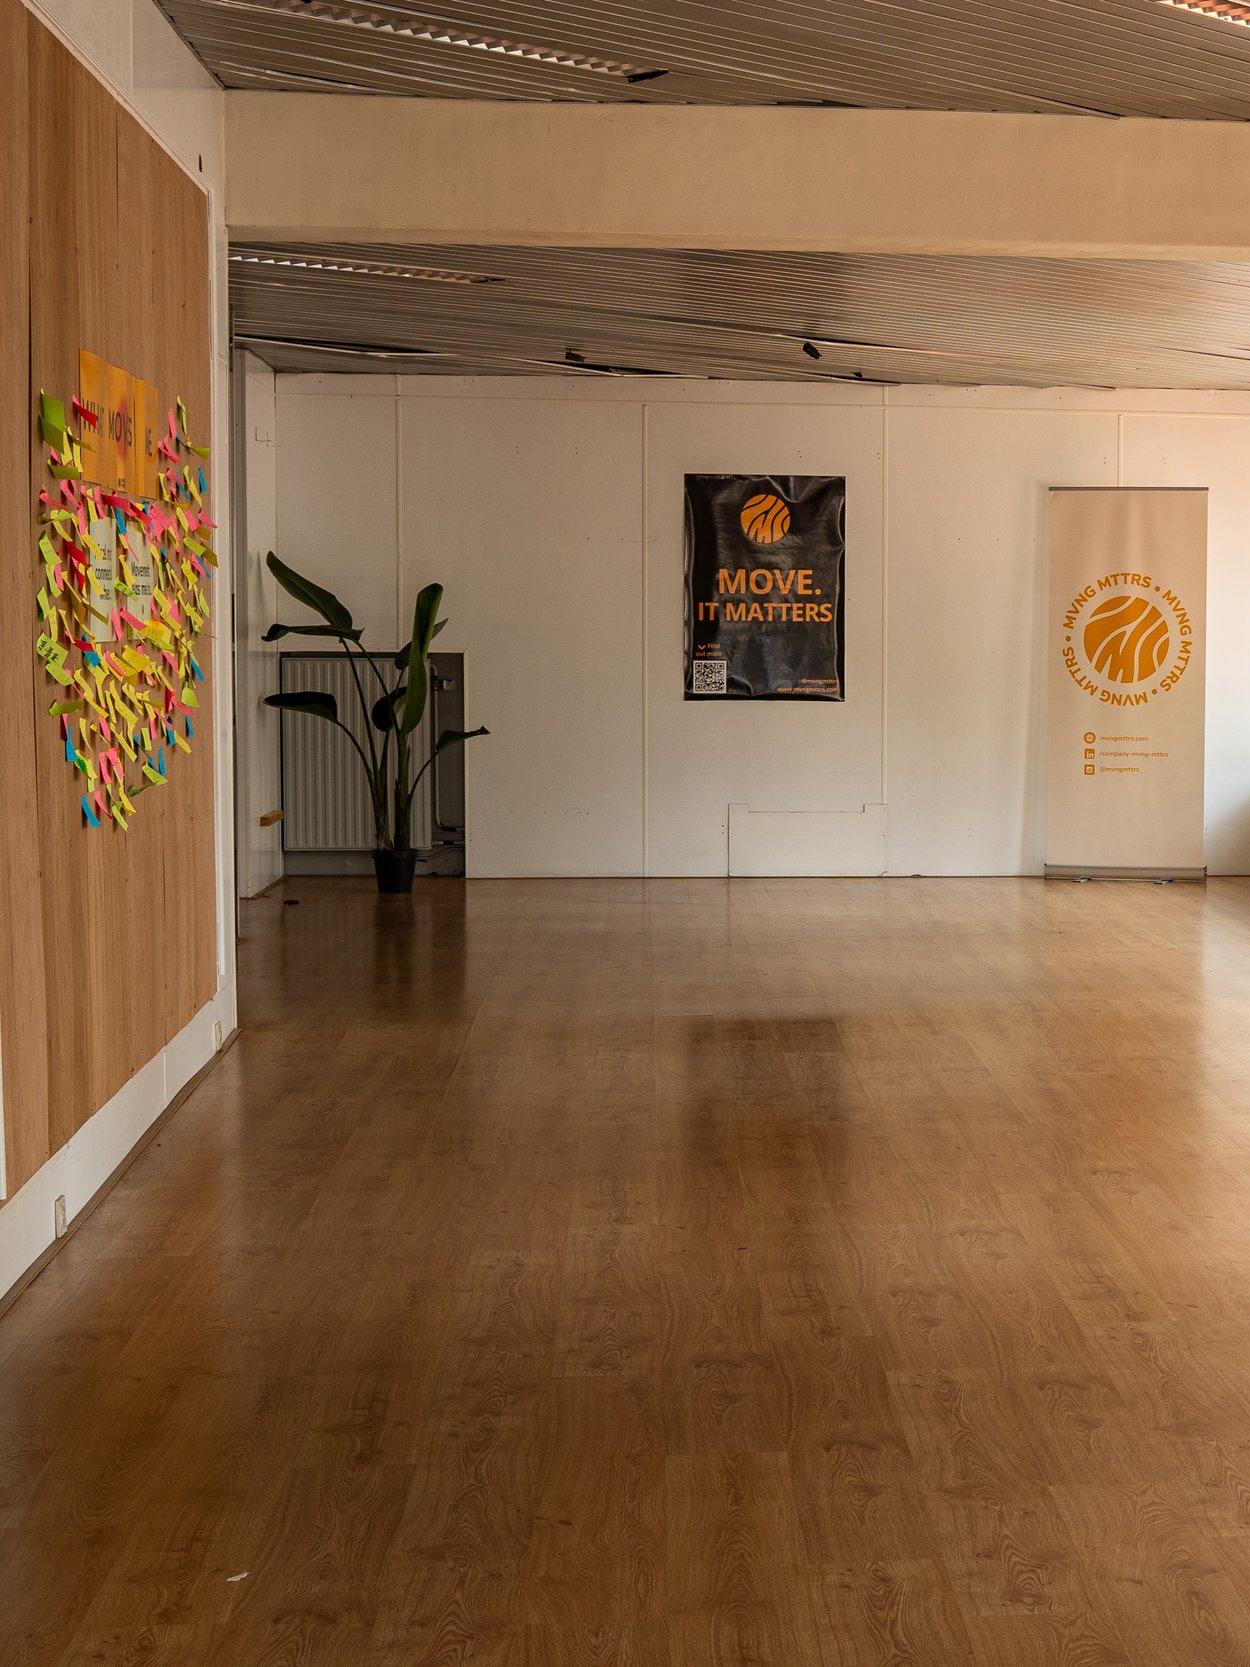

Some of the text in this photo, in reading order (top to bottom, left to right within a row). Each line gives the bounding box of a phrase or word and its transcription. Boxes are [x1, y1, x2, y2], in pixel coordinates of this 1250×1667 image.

[109, 408, 133, 447] MOVS
[718, 568, 821, 595] MOVE.
[1062, 572, 1152, 630] MVNG MTTRS
[698, 602, 832, 621] IT MATTERS
[1159, 589, 1193, 693] MVNG MTTRS
[1062, 646, 1148, 707] MVNG MTTRS
